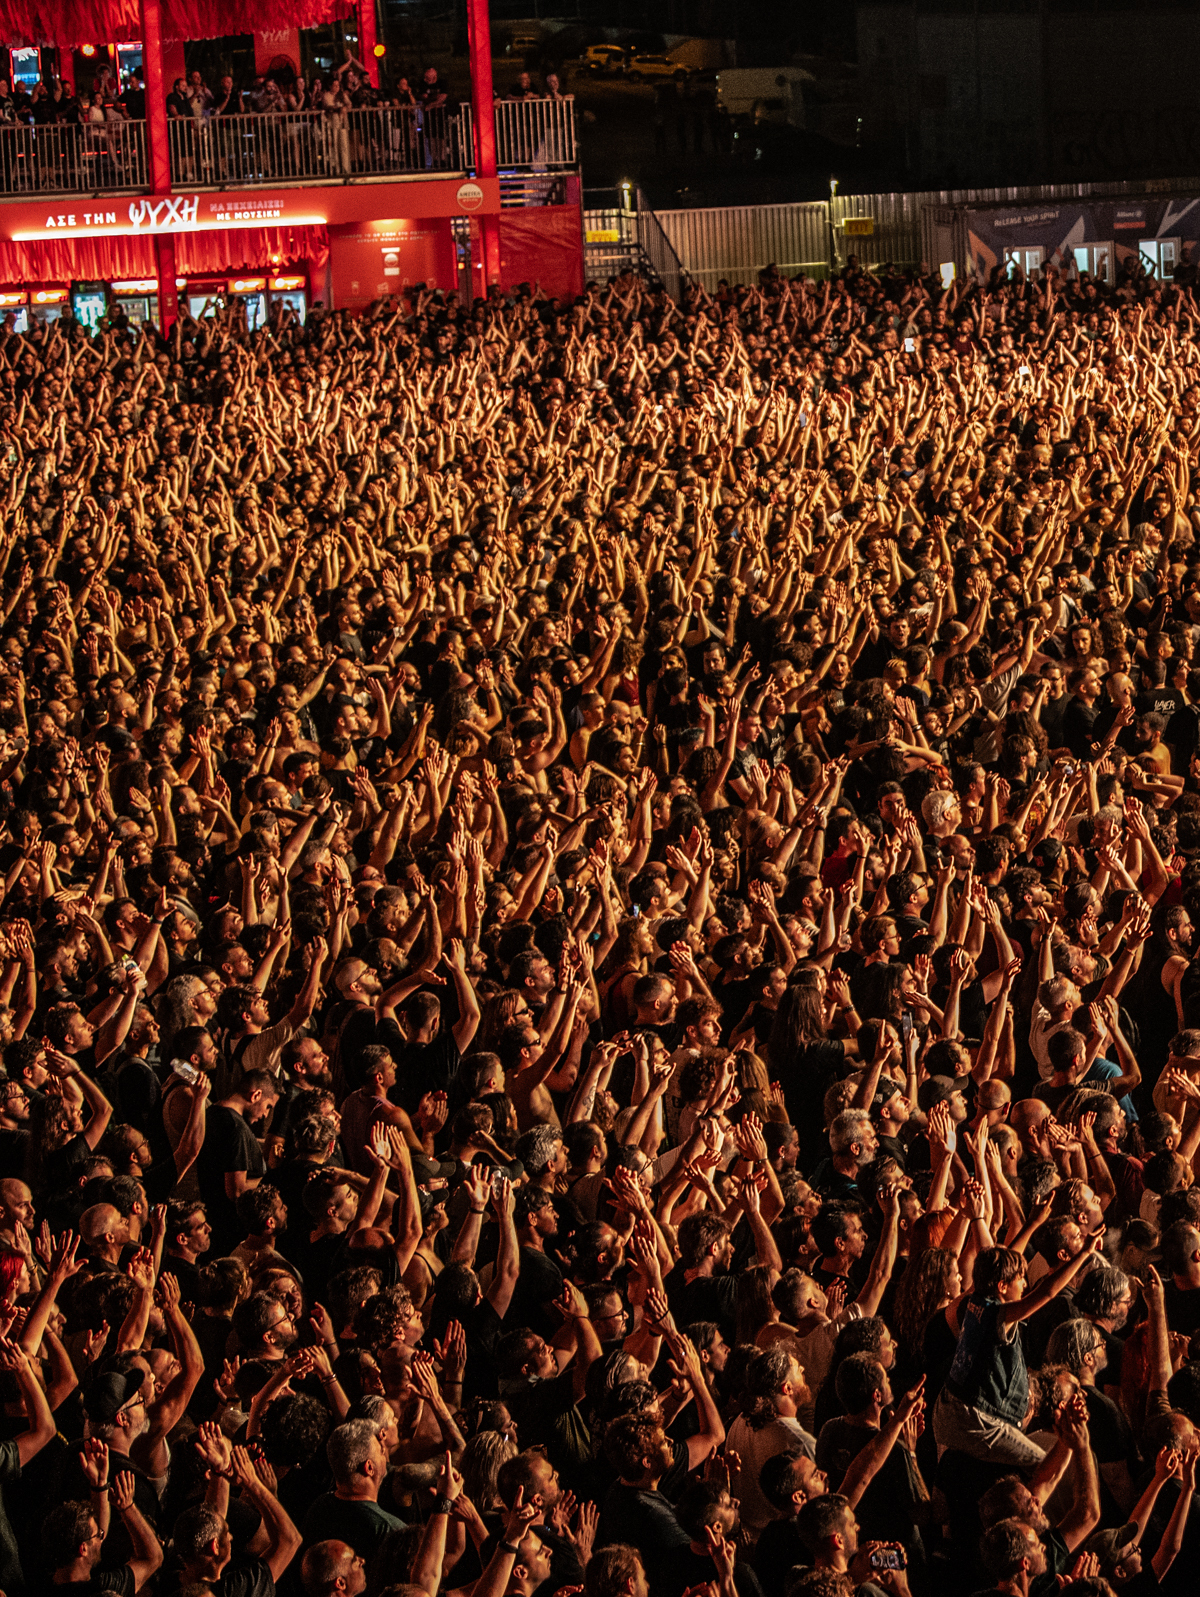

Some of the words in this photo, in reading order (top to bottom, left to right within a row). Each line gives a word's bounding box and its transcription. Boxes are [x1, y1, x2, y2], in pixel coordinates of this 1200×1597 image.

[45, 214, 77, 228] ΑΣΕ
[83, 212, 117, 225] ΤΗΝ
[128, 195, 200, 231] ΨΥΧΗ
[216, 212, 231, 221] ΜΕ
[234, 209, 281, 219] ΜΟΥΣΙΚΗ
